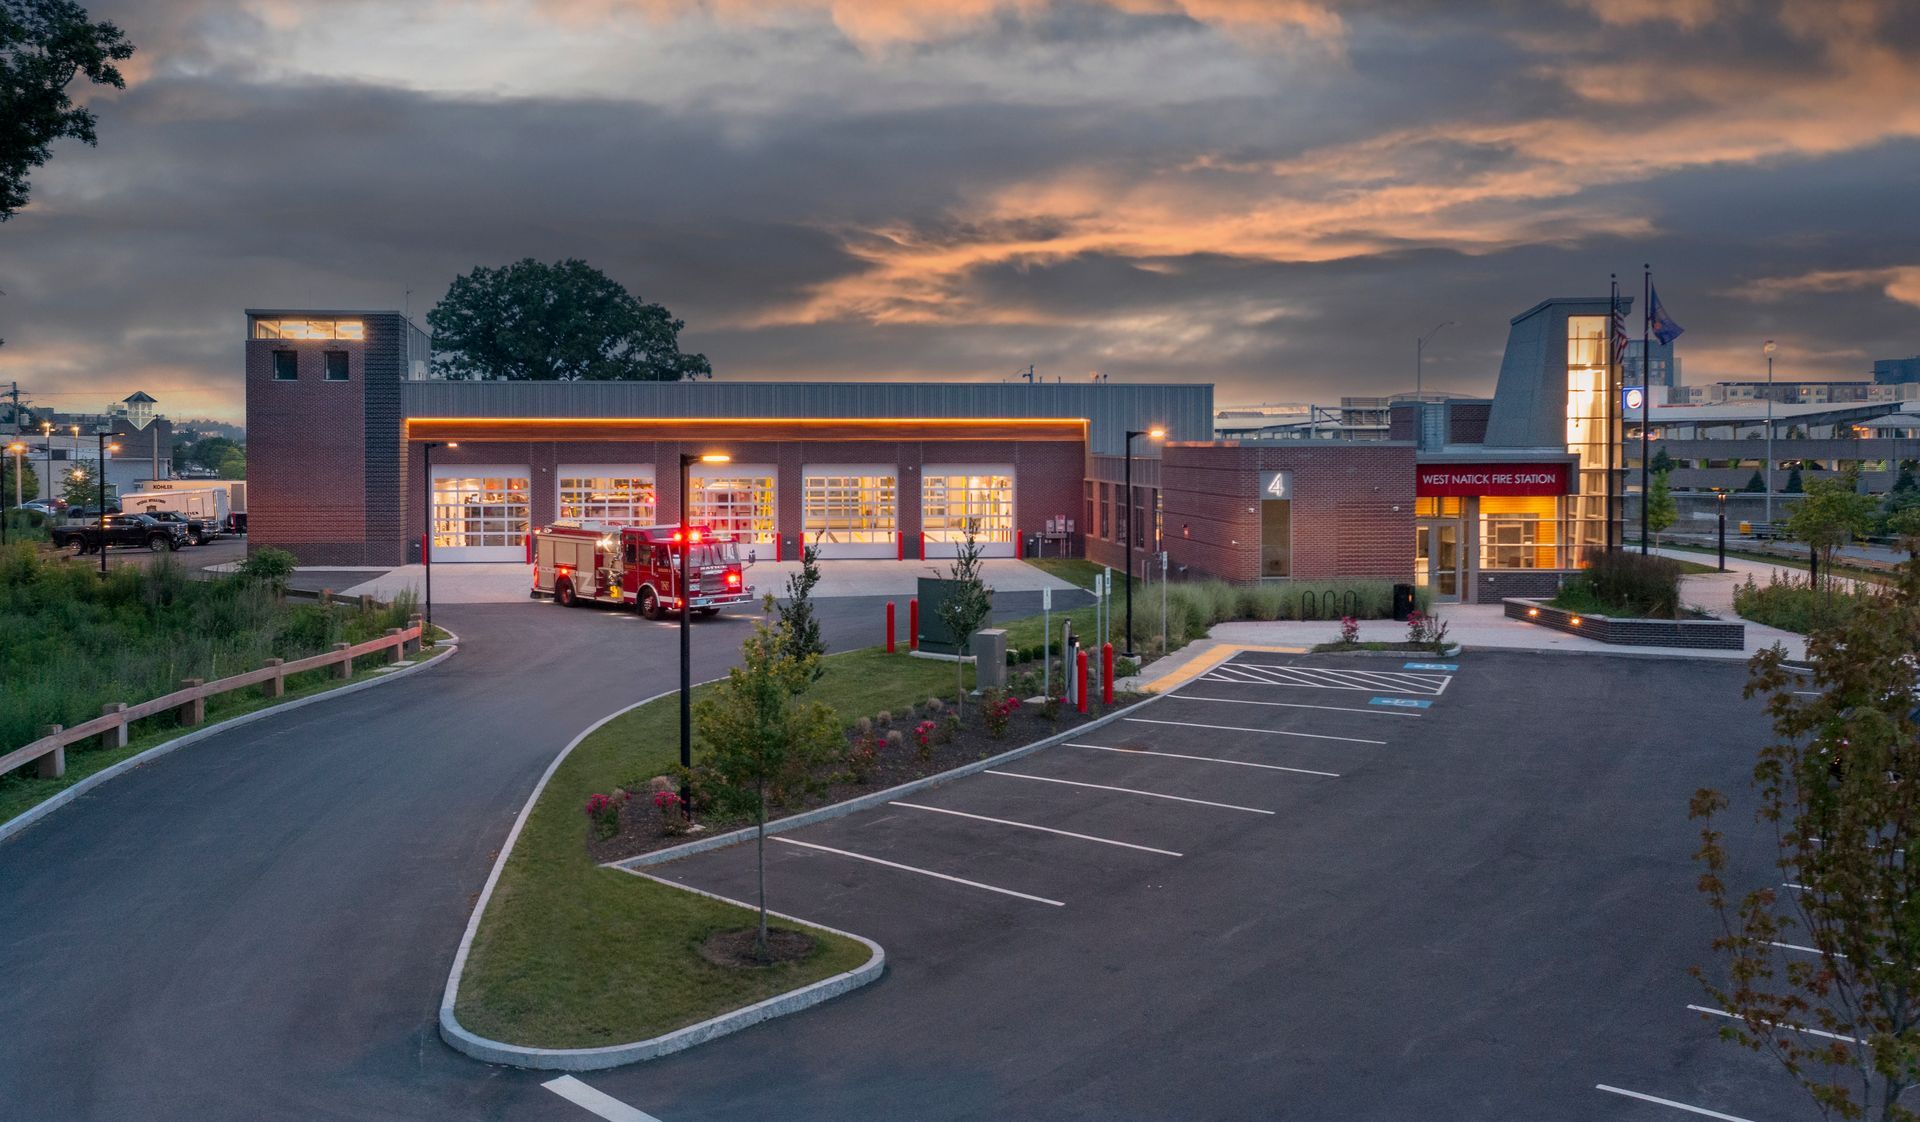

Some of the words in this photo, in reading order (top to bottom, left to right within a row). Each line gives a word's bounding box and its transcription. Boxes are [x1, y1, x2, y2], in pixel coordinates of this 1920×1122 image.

[1268, 472, 1285, 497] 4
[1422, 474, 1449, 485] WEST
[1452, 474, 1489, 484] NATICK
[1492, 474, 1512, 484] FIRE
[1514, 473, 1555, 484] STATION
